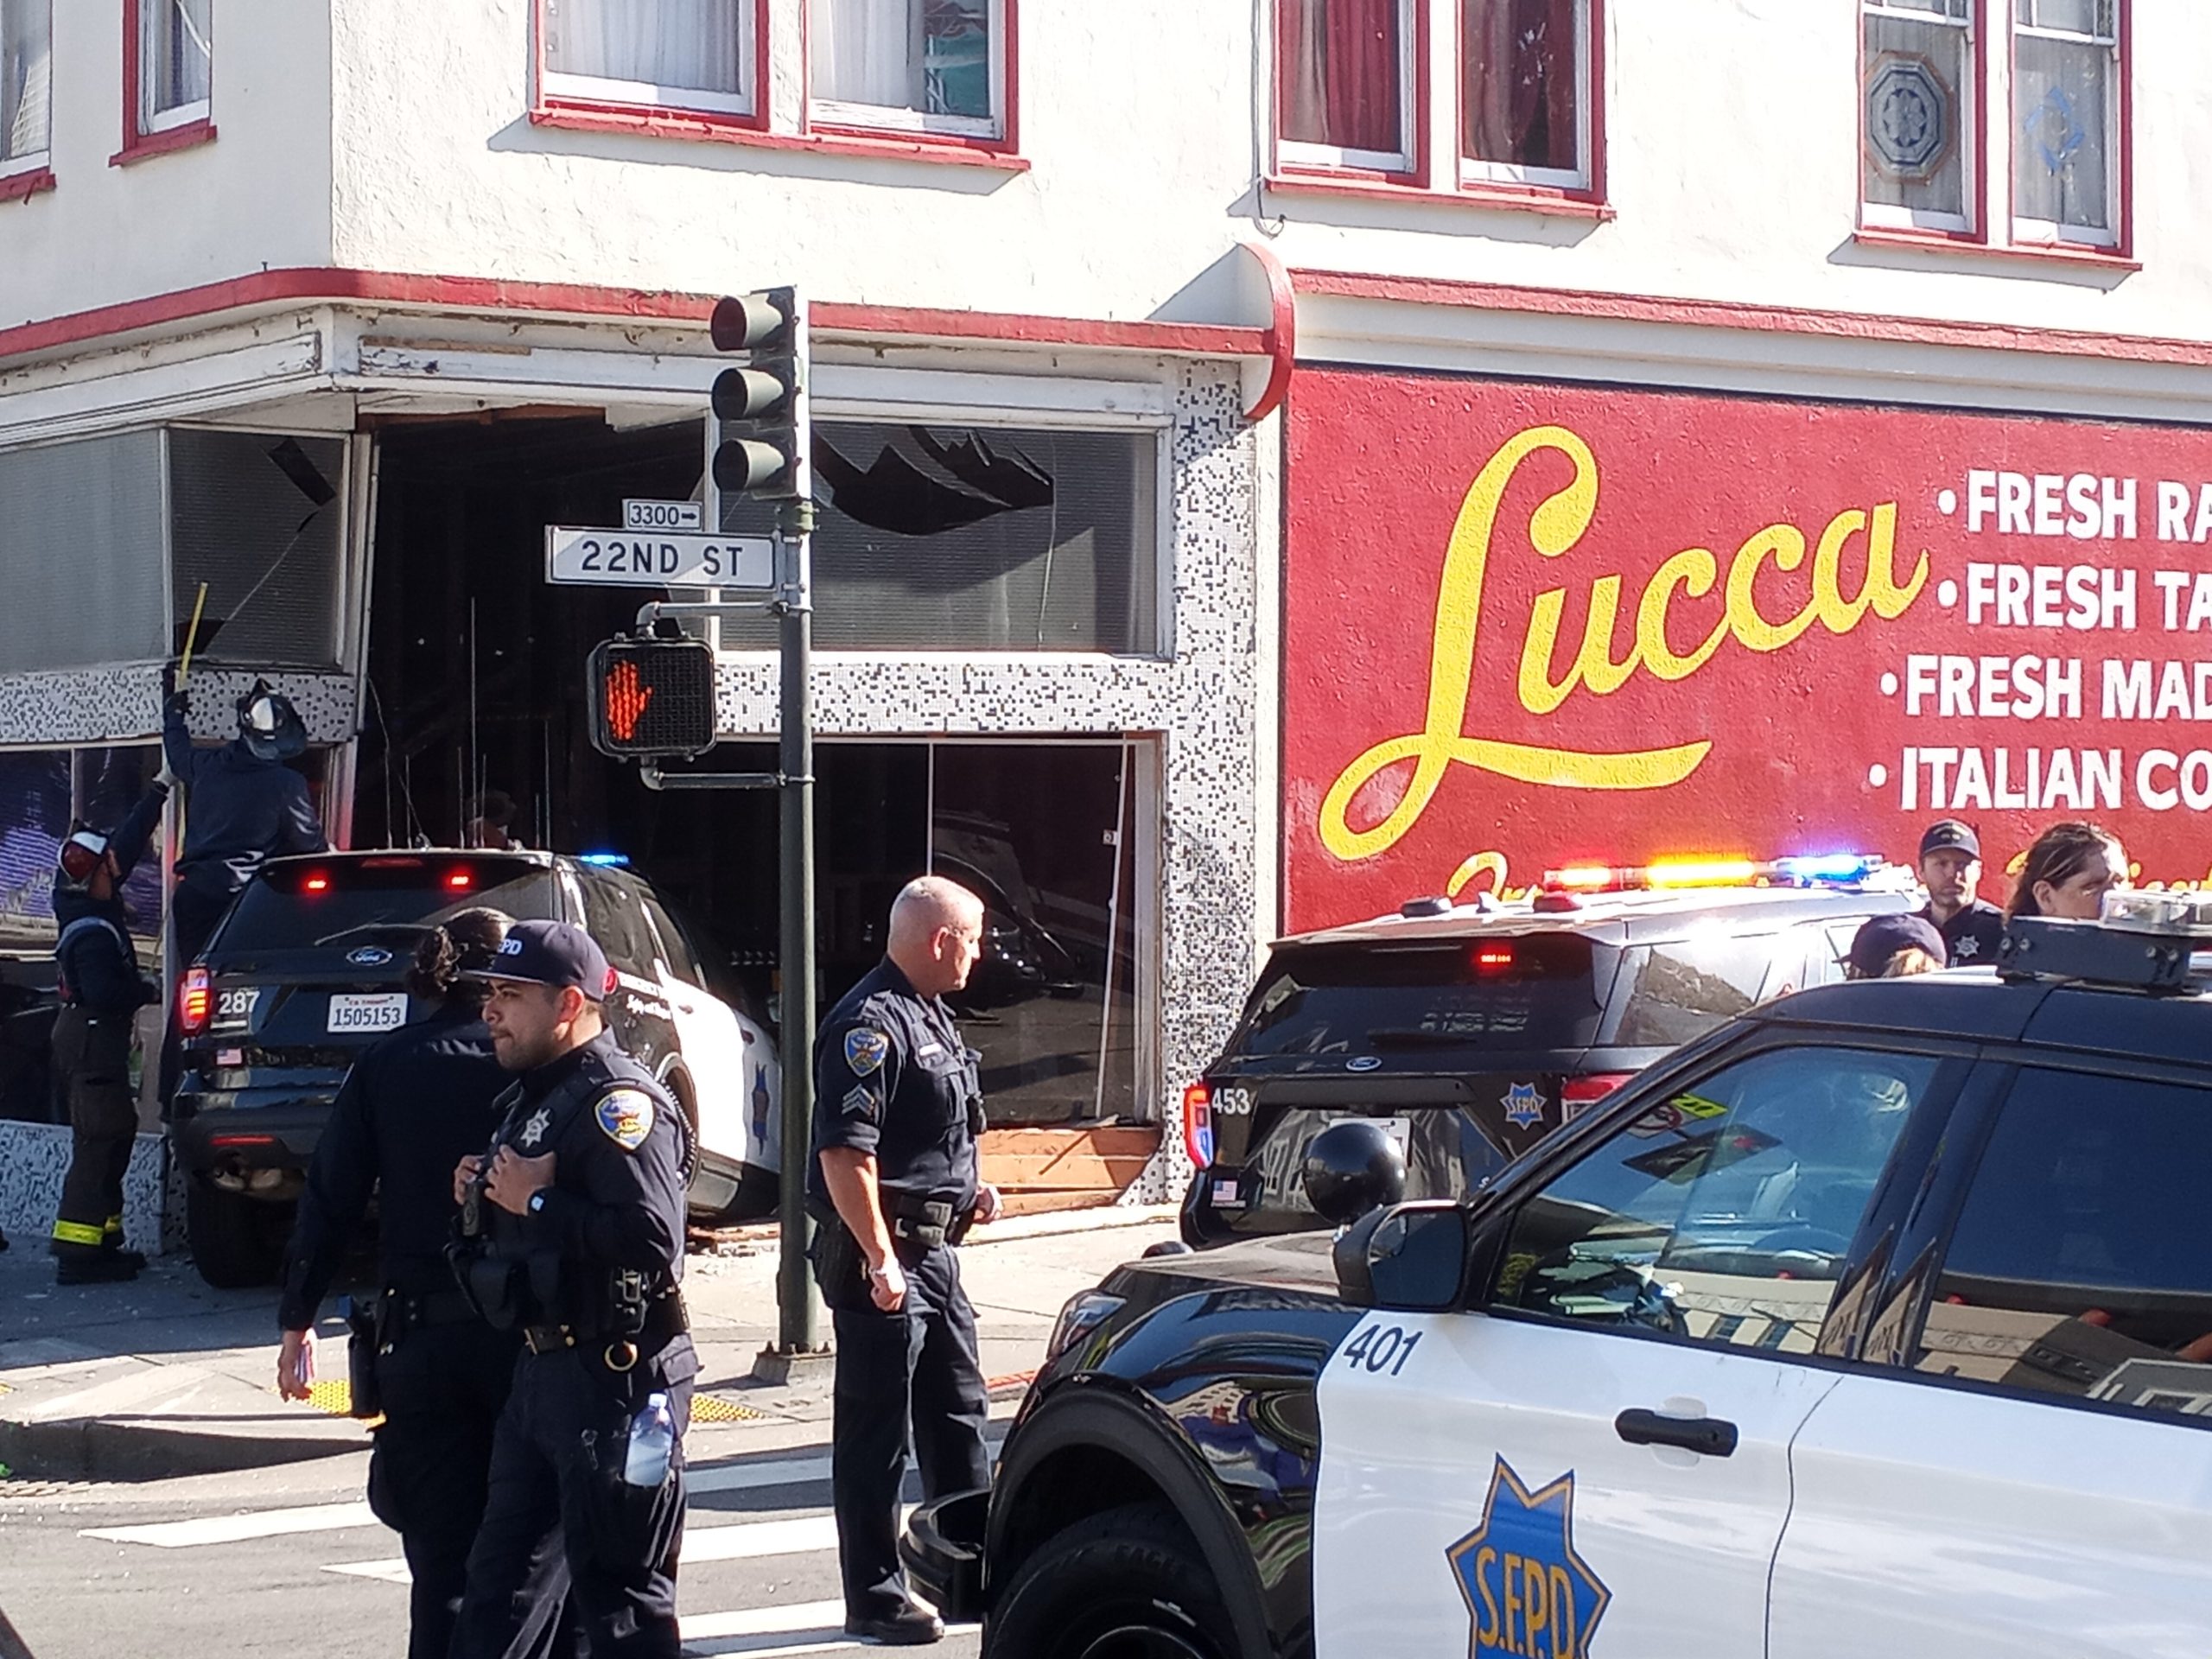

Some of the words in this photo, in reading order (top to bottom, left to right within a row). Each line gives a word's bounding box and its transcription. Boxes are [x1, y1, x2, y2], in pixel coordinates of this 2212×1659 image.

[630, 505, 679, 525] 3300
[1967, 468, 2138, 540] FRESH
[581, 539, 678, 574] 22ND
[702, 545, 743, 576] ST
[1966, 562, 2138, 631] FRESH
[2153, 569, 2212, 632] TA
[1319, 424, 1930, 861] Lucca
[1905, 653, 2082, 720] FRESH
[1901, 747, 2122, 810] ITALIAN
[2135, 747, 2212, 811] CO
[219, 990, 261, 1015] 287
[334, 1007, 401, 1027] 1505153
[1211, 1087, 1251, 1116] 453
[1343, 1324, 1423, 1376] 401
